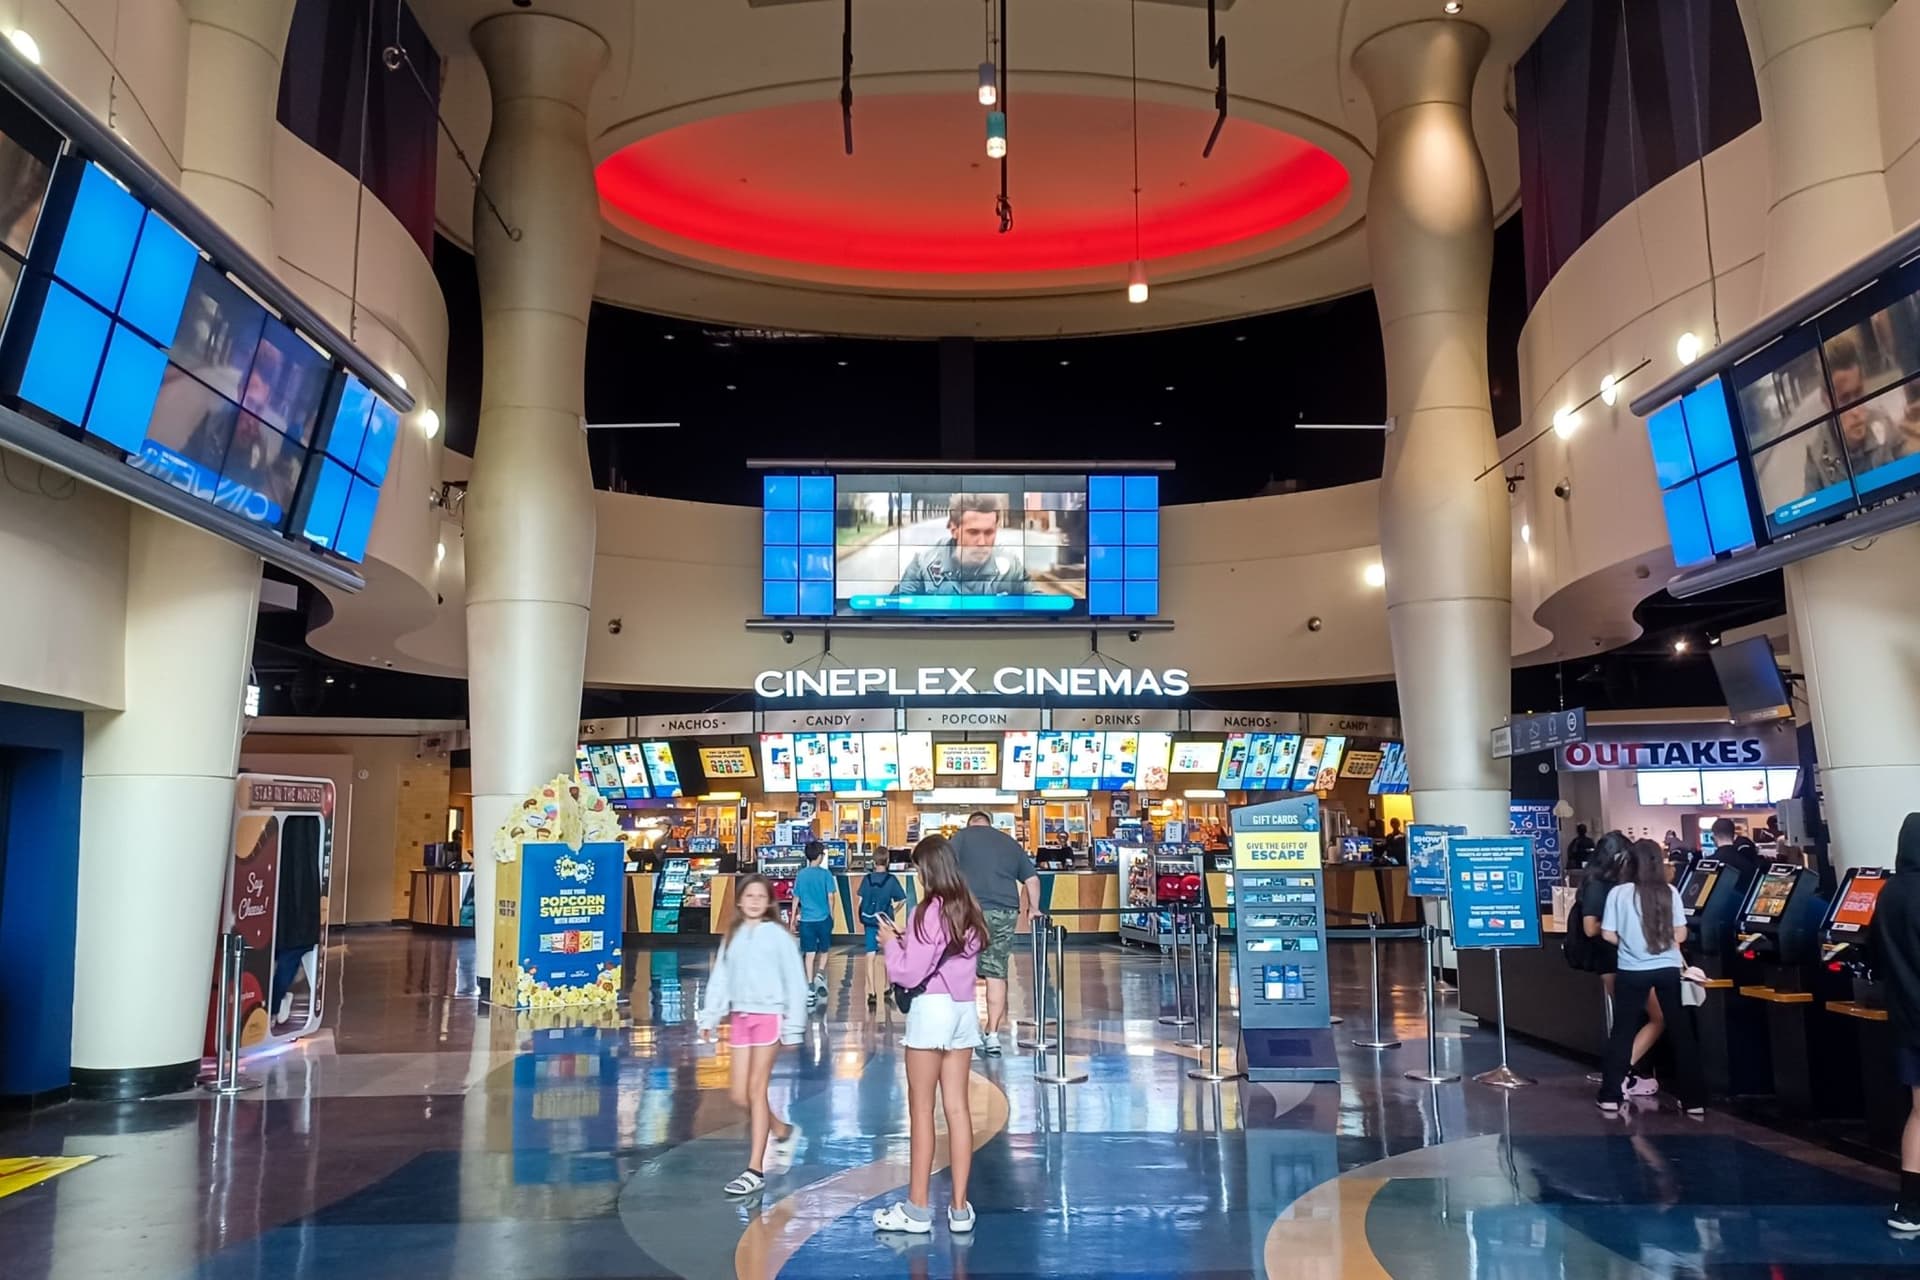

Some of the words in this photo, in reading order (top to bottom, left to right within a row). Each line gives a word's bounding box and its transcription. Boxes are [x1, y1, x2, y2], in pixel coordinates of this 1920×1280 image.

[754, 667, 978, 698] CINEPLEX
[992, 667, 1190, 697] CINEMAS
[668, 718, 719, 731] NACHOS
[806, 715, 851, 726] CANDY
[941, 714, 1007, 725] POPCORN
[1095, 714, 1141, 725] DRINKS
[1224, 716, 1271, 728] NACHOS
[1338, 720, 1369, 731] CANDY
[1565, 739, 1762, 766] OUTTAKES
[254, 786, 272, 800] STAR
[274, 786, 282, 801] IN
[284, 786, 296, 802] THE
[297, 787, 321, 802] MOVIES
[1252, 814, 1270, 825] GIFT
[1272, 814, 1299, 825] CARDS
[1246, 842, 1263, 850] GIVE
[1251, 850, 1305, 860] ESCAPE
[247, 872, 264, 897] Say
[540, 895, 606, 907] POPCORN
[238, 895, 269, 920] Cheese!
[540, 905, 605, 917] SWEETER
